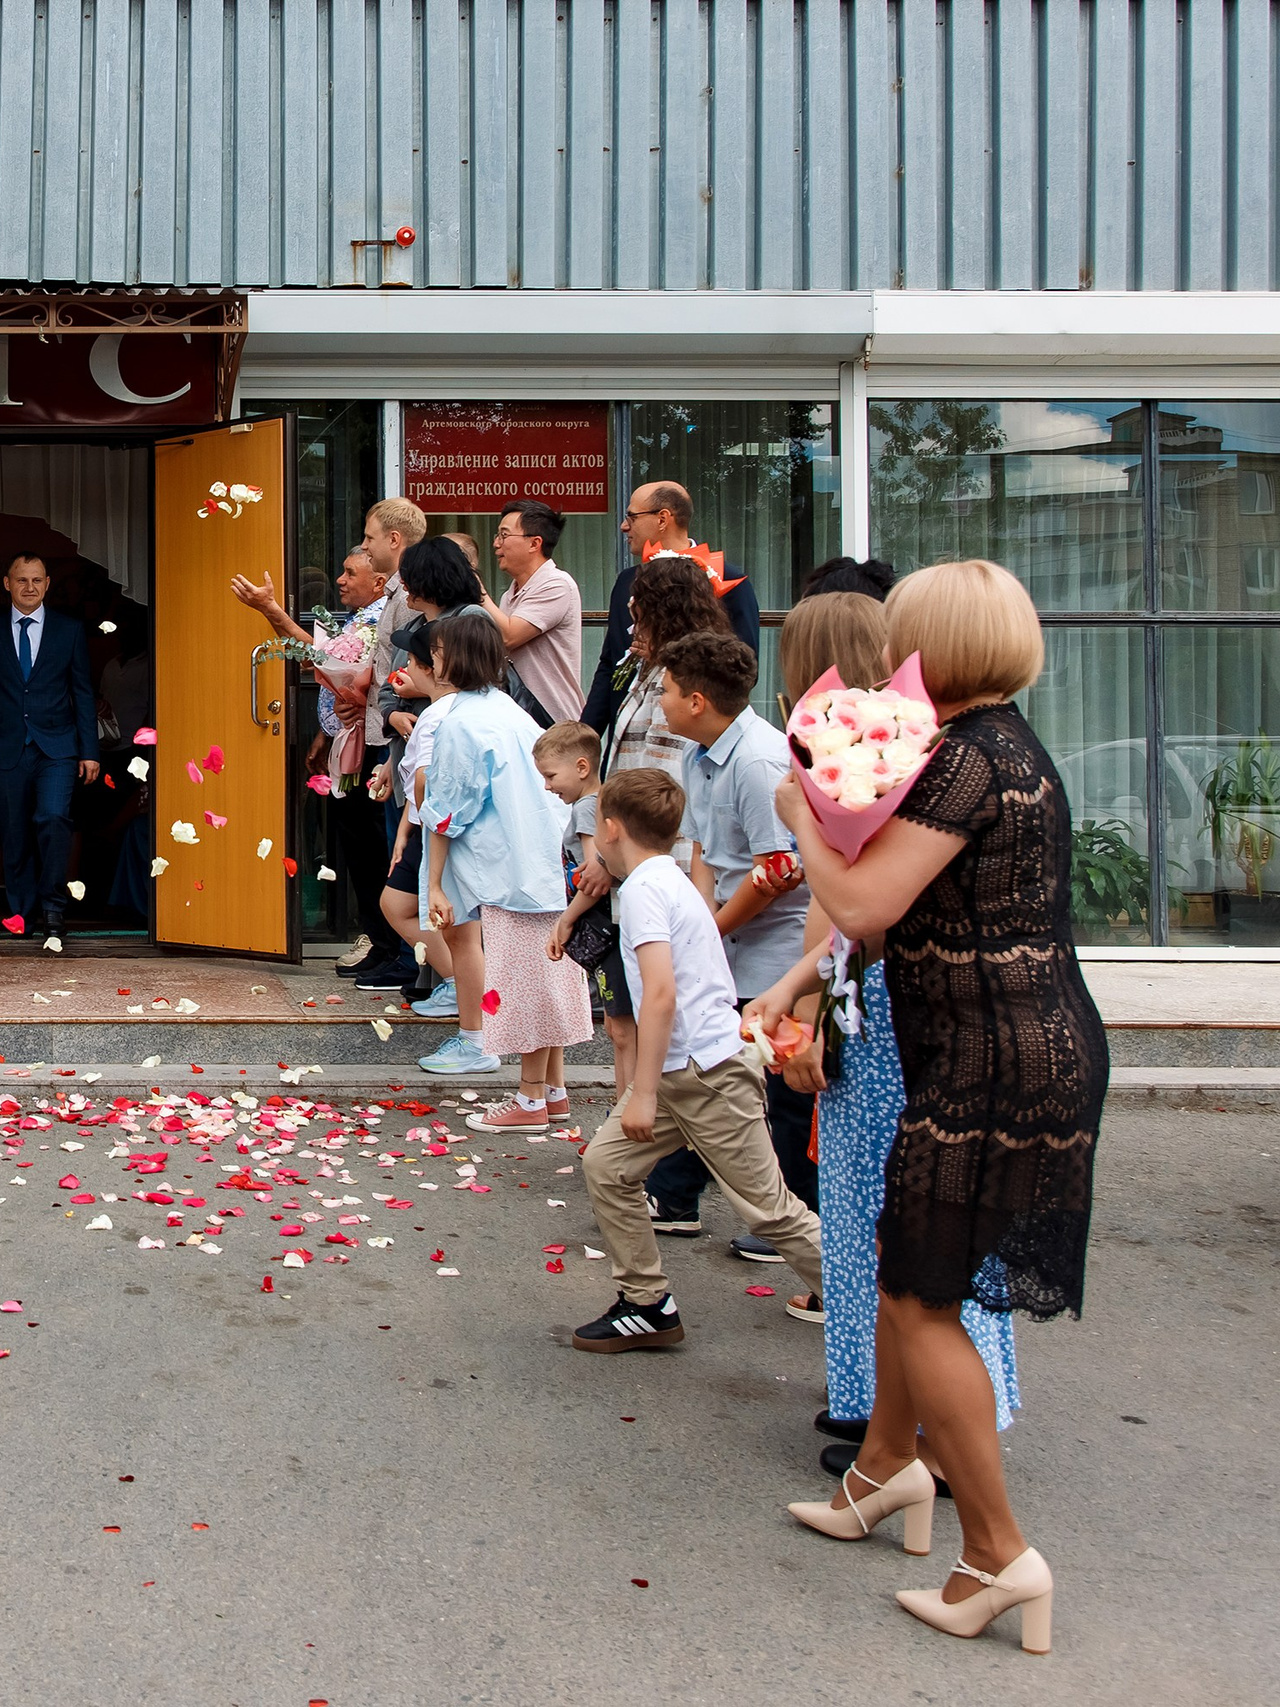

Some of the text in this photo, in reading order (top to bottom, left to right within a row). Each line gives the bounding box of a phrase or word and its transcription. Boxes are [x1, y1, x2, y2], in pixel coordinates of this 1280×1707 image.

[422, 419, 590, 430] Артемовского городского округа
[408, 449, 605, 473] Управление записи актов
[408, 482, 605, 501] гражданского состояния
